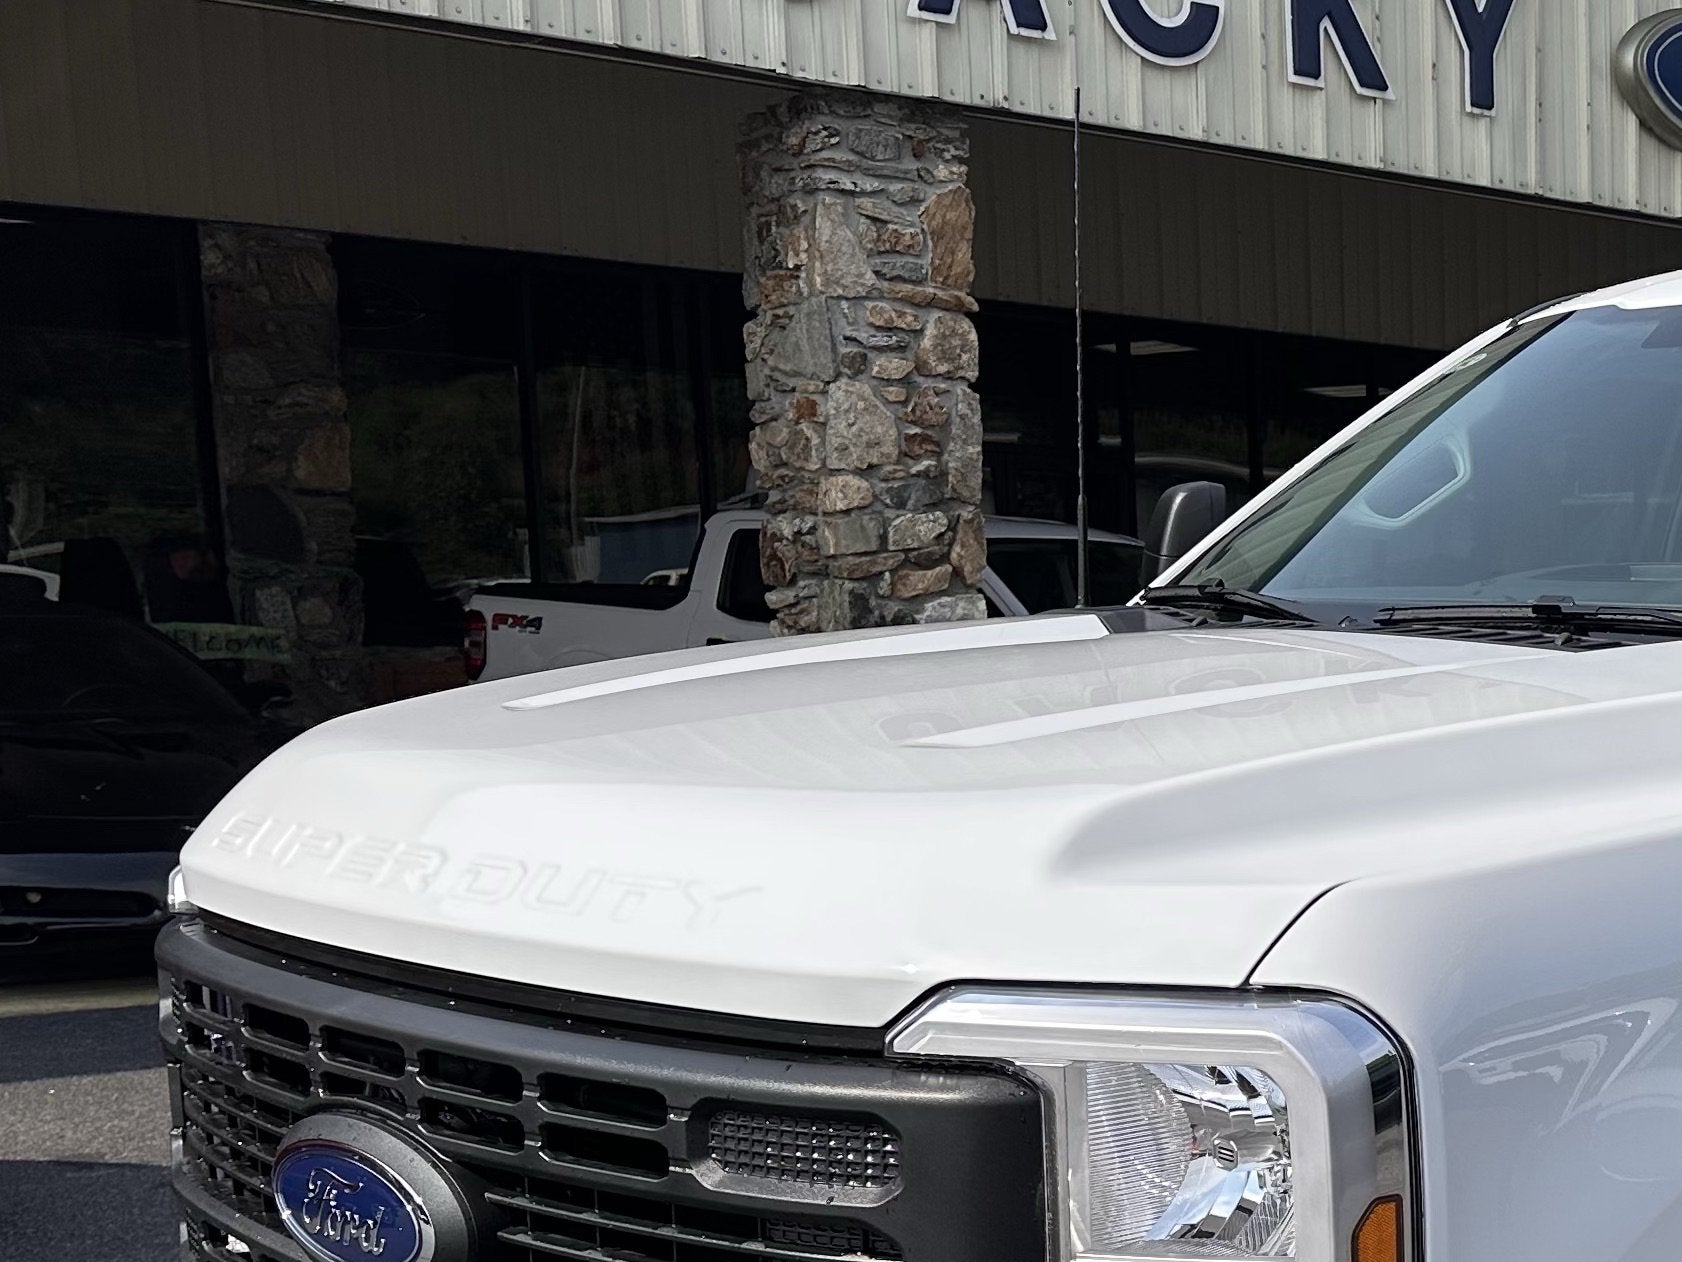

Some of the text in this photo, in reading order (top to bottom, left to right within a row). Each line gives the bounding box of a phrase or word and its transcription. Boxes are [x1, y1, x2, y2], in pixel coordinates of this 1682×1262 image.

[490, 612, 544, 631] FX4
[209, 809, 767, 929] SUPER DUTY
[301, 1166, 387, 1256] Ford
